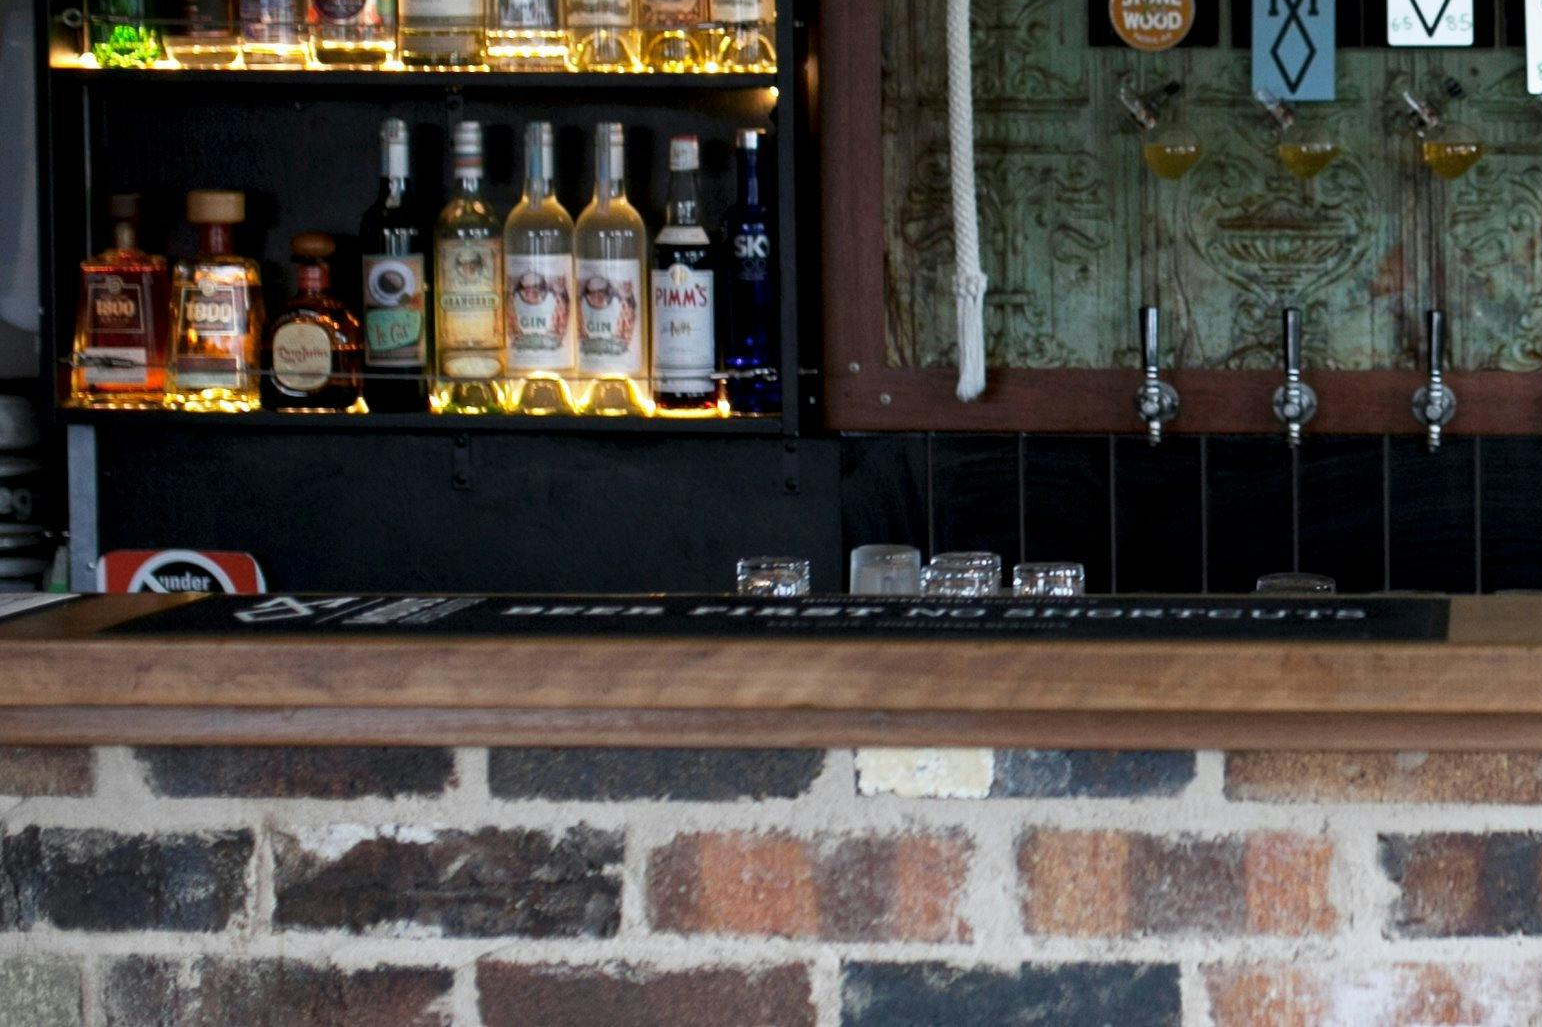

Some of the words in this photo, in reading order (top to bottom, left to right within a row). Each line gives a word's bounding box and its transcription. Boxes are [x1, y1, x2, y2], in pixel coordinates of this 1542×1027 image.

[1122, 10, 1182, 31] WOOD
[655, 284, 709, 308] PIMM'S
[520, 316, 547, 328] GIN
[586, 320, 612, 332] GIN
[502, 605, 666, 617] BEER
[688, 605, 884, 617] FIRST
[904, 607, 986, 618] NO
[1003, 607, 1366, 619] SHORTCUTS
